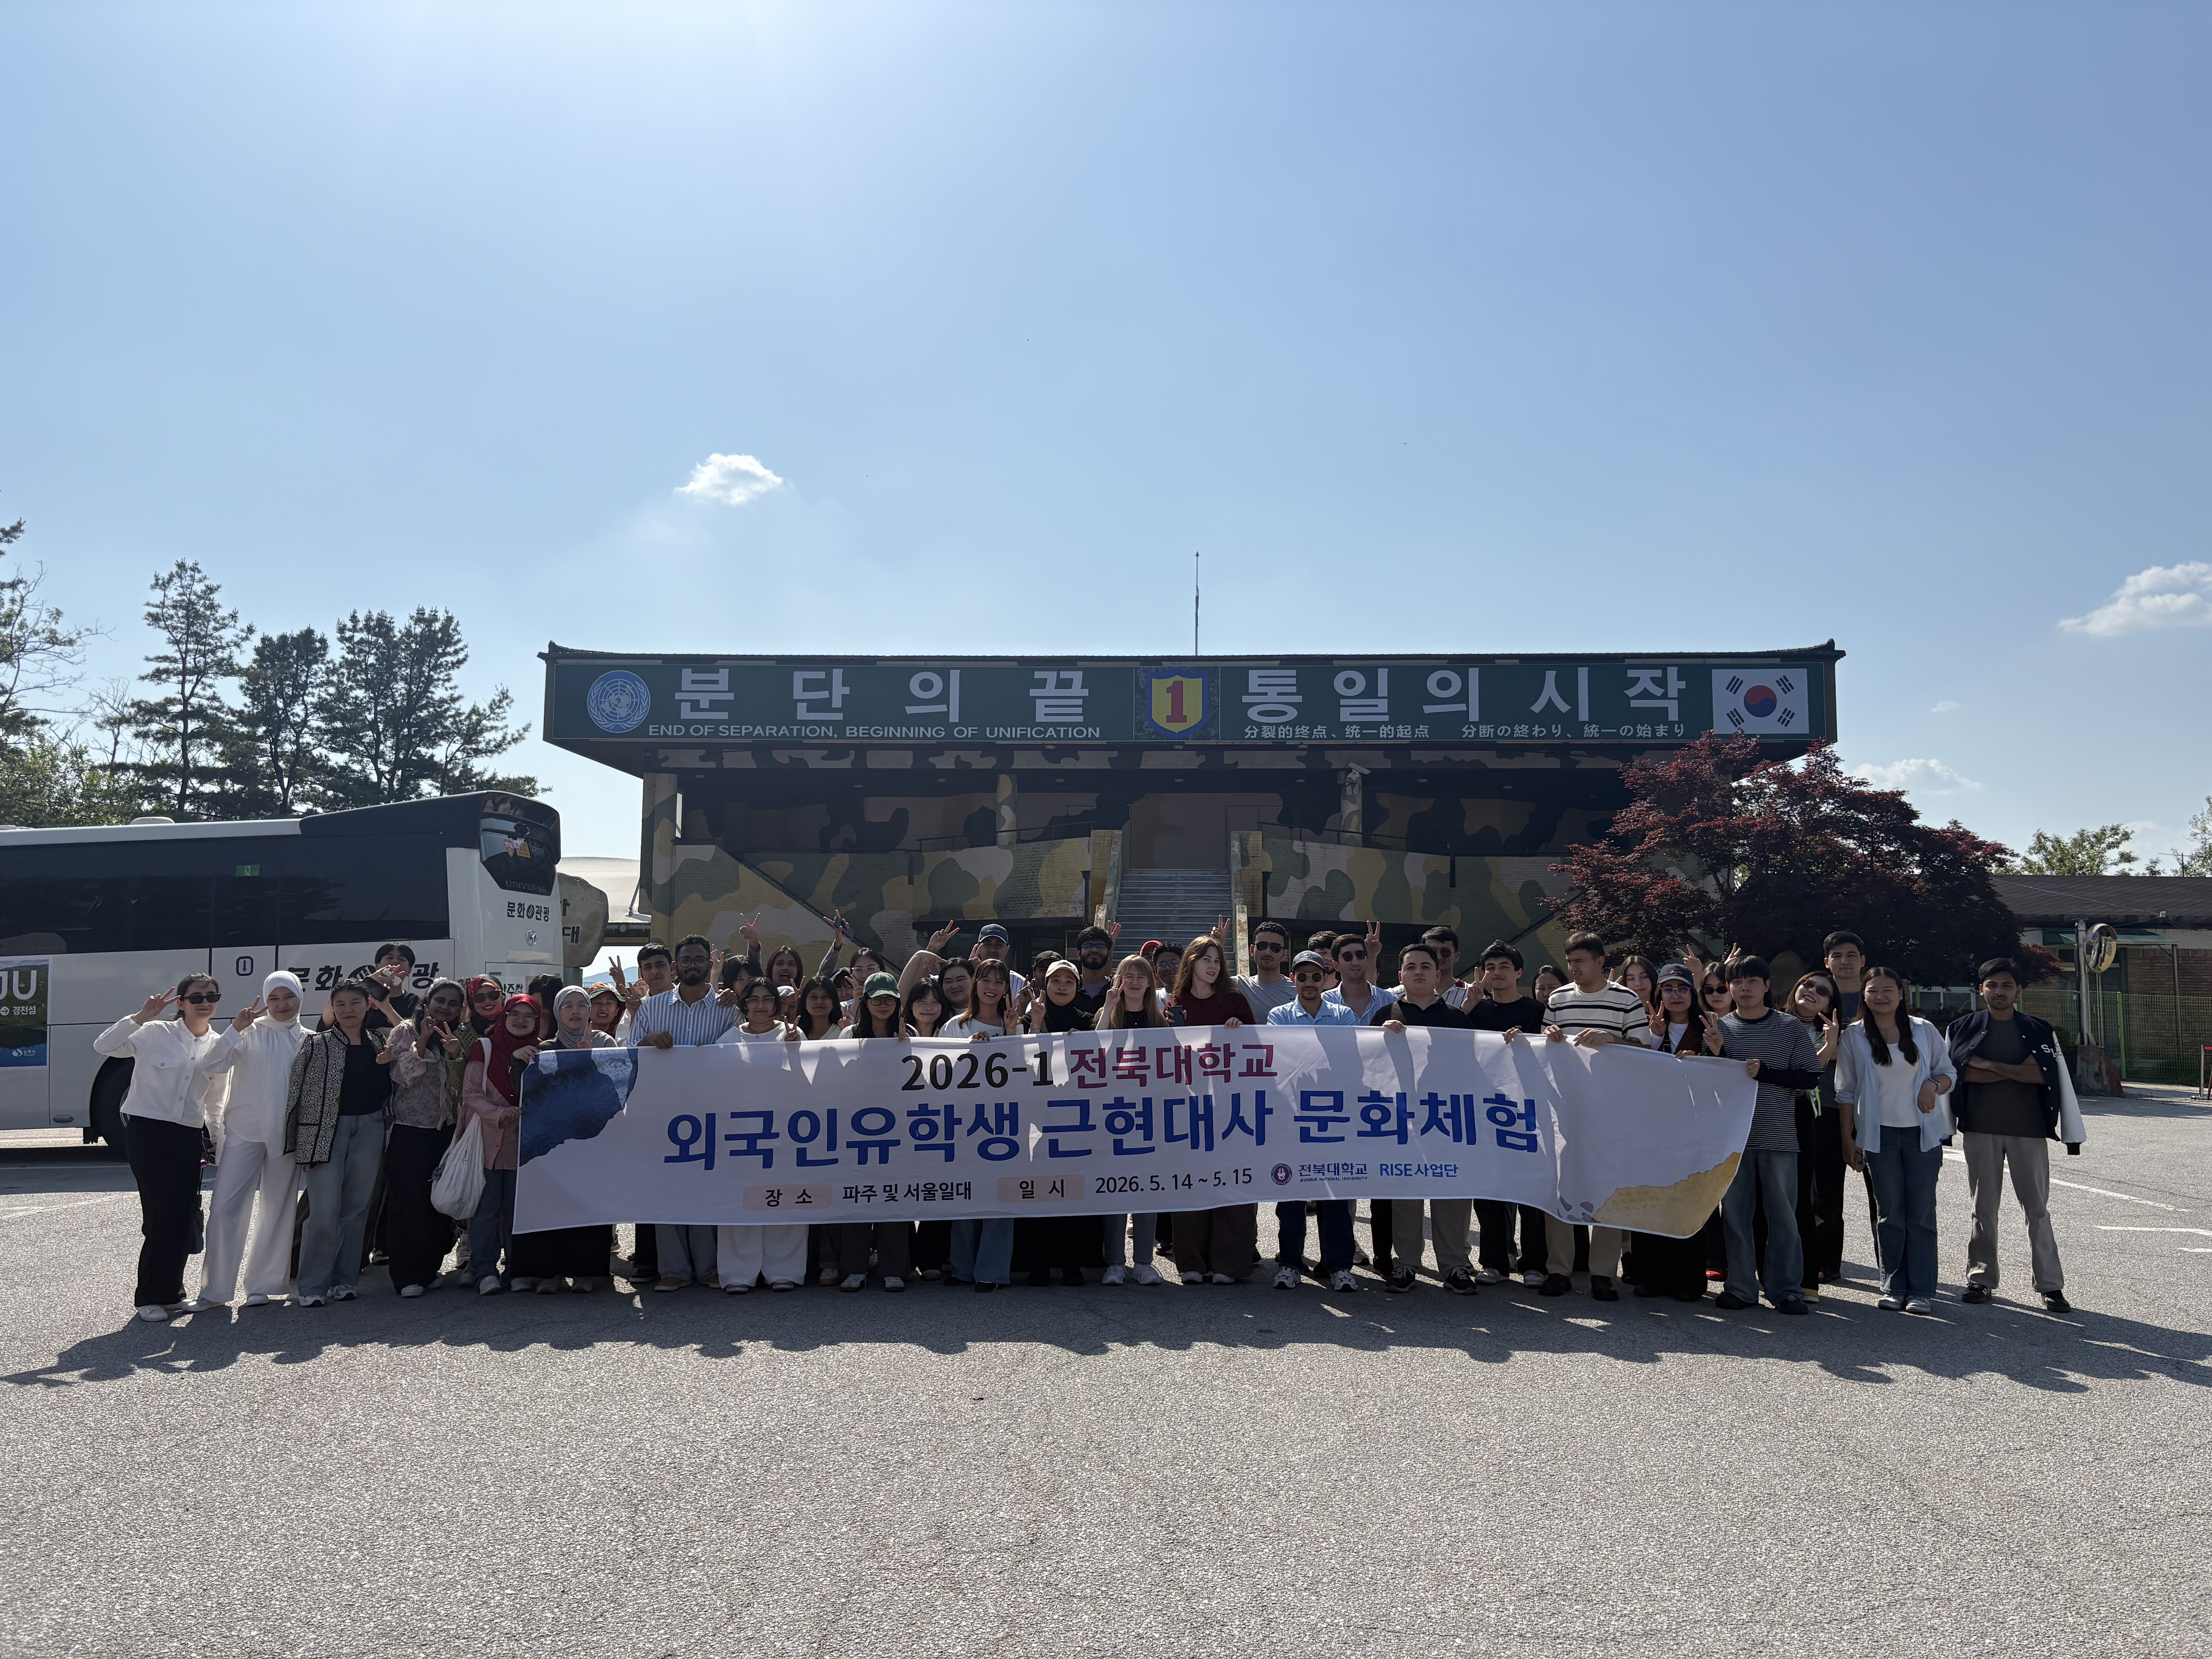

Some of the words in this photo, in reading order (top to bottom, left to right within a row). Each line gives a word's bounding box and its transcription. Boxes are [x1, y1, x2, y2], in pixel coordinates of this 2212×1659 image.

[1029, 671, 1089, 722] 끝
[1166, 680, 1187, 723] 1
[649, 725, 685, 736] END
[689, 725, 714, 737] OF
[718, 725, 838, 739] SEPARATION,
[846, 726, 945, 738] BEGINNING
[953, 726, 978, 738] OF
[986, 726, 1100, 738] UNIFICATION
[507, 901, 526, 919] 문화
[535, 905, 550, 922] 관광
[12, 1005, 36, 1015] 경천섬
[901, 1051, 1054, 1091] 2026-1
[1070, 1042, 1278, 1089] 전북대학교
[664, 1101, 1020, 1171] 외국인유학생
[1042, 1090, 1273, 1158] 근현대사
[1293, 1090, 1538, 1153] 문화체험
[1298, 1162, 1368, 1176] 전북대학교
[842, 1184, 878, 1204] 파주
[883, 1184, 900, 1202] 및
[903, 1181, 972, 1202] 서울일대
